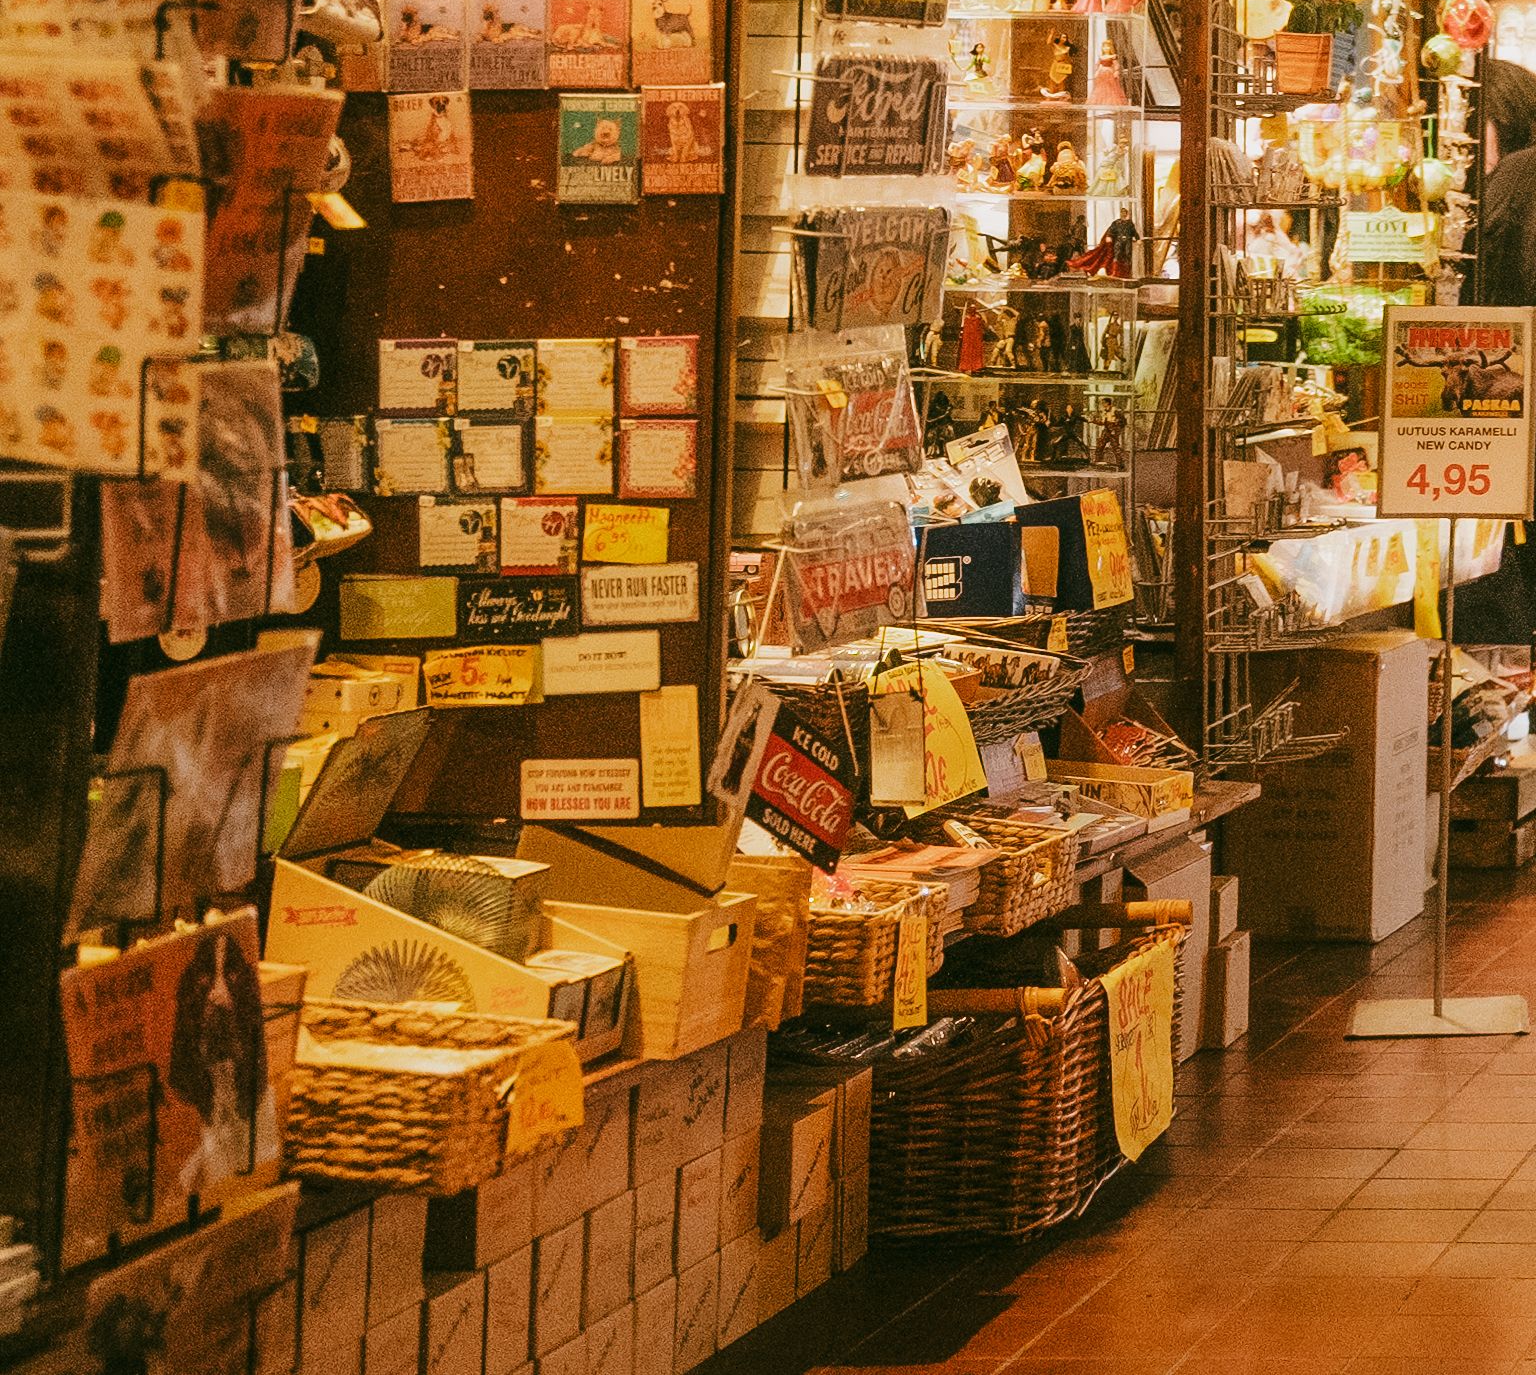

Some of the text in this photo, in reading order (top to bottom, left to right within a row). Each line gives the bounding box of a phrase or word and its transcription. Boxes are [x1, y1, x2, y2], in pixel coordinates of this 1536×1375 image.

[815, 143, 868, 166] SERICE
[594, 166, 634, 182] LIVELY
[1408, 327, 1512, 349] HIRVEN
[1394, 381, 1429, 391] MOOSE
[1394, 393, 1430, 406] SHIT
[1462, 399, 1522, 412] PASKAA
[1397, 426, 1517, 437] UUTUUS KARAMELLI
[1416, 440, 1492, 451] NEW CANDY
[1406, 463, 1491, 501] 4,95
[591, 574, 688, 599] NEVER RUN FASTER
[808, 552, 906, 602] TRAVEL
[792, 725, 840, 771] ICE COLD
[526, 796, 631, 811] HOW BLESSED YOU ARE
[762, 808, 818, 854] SOLD HERE
